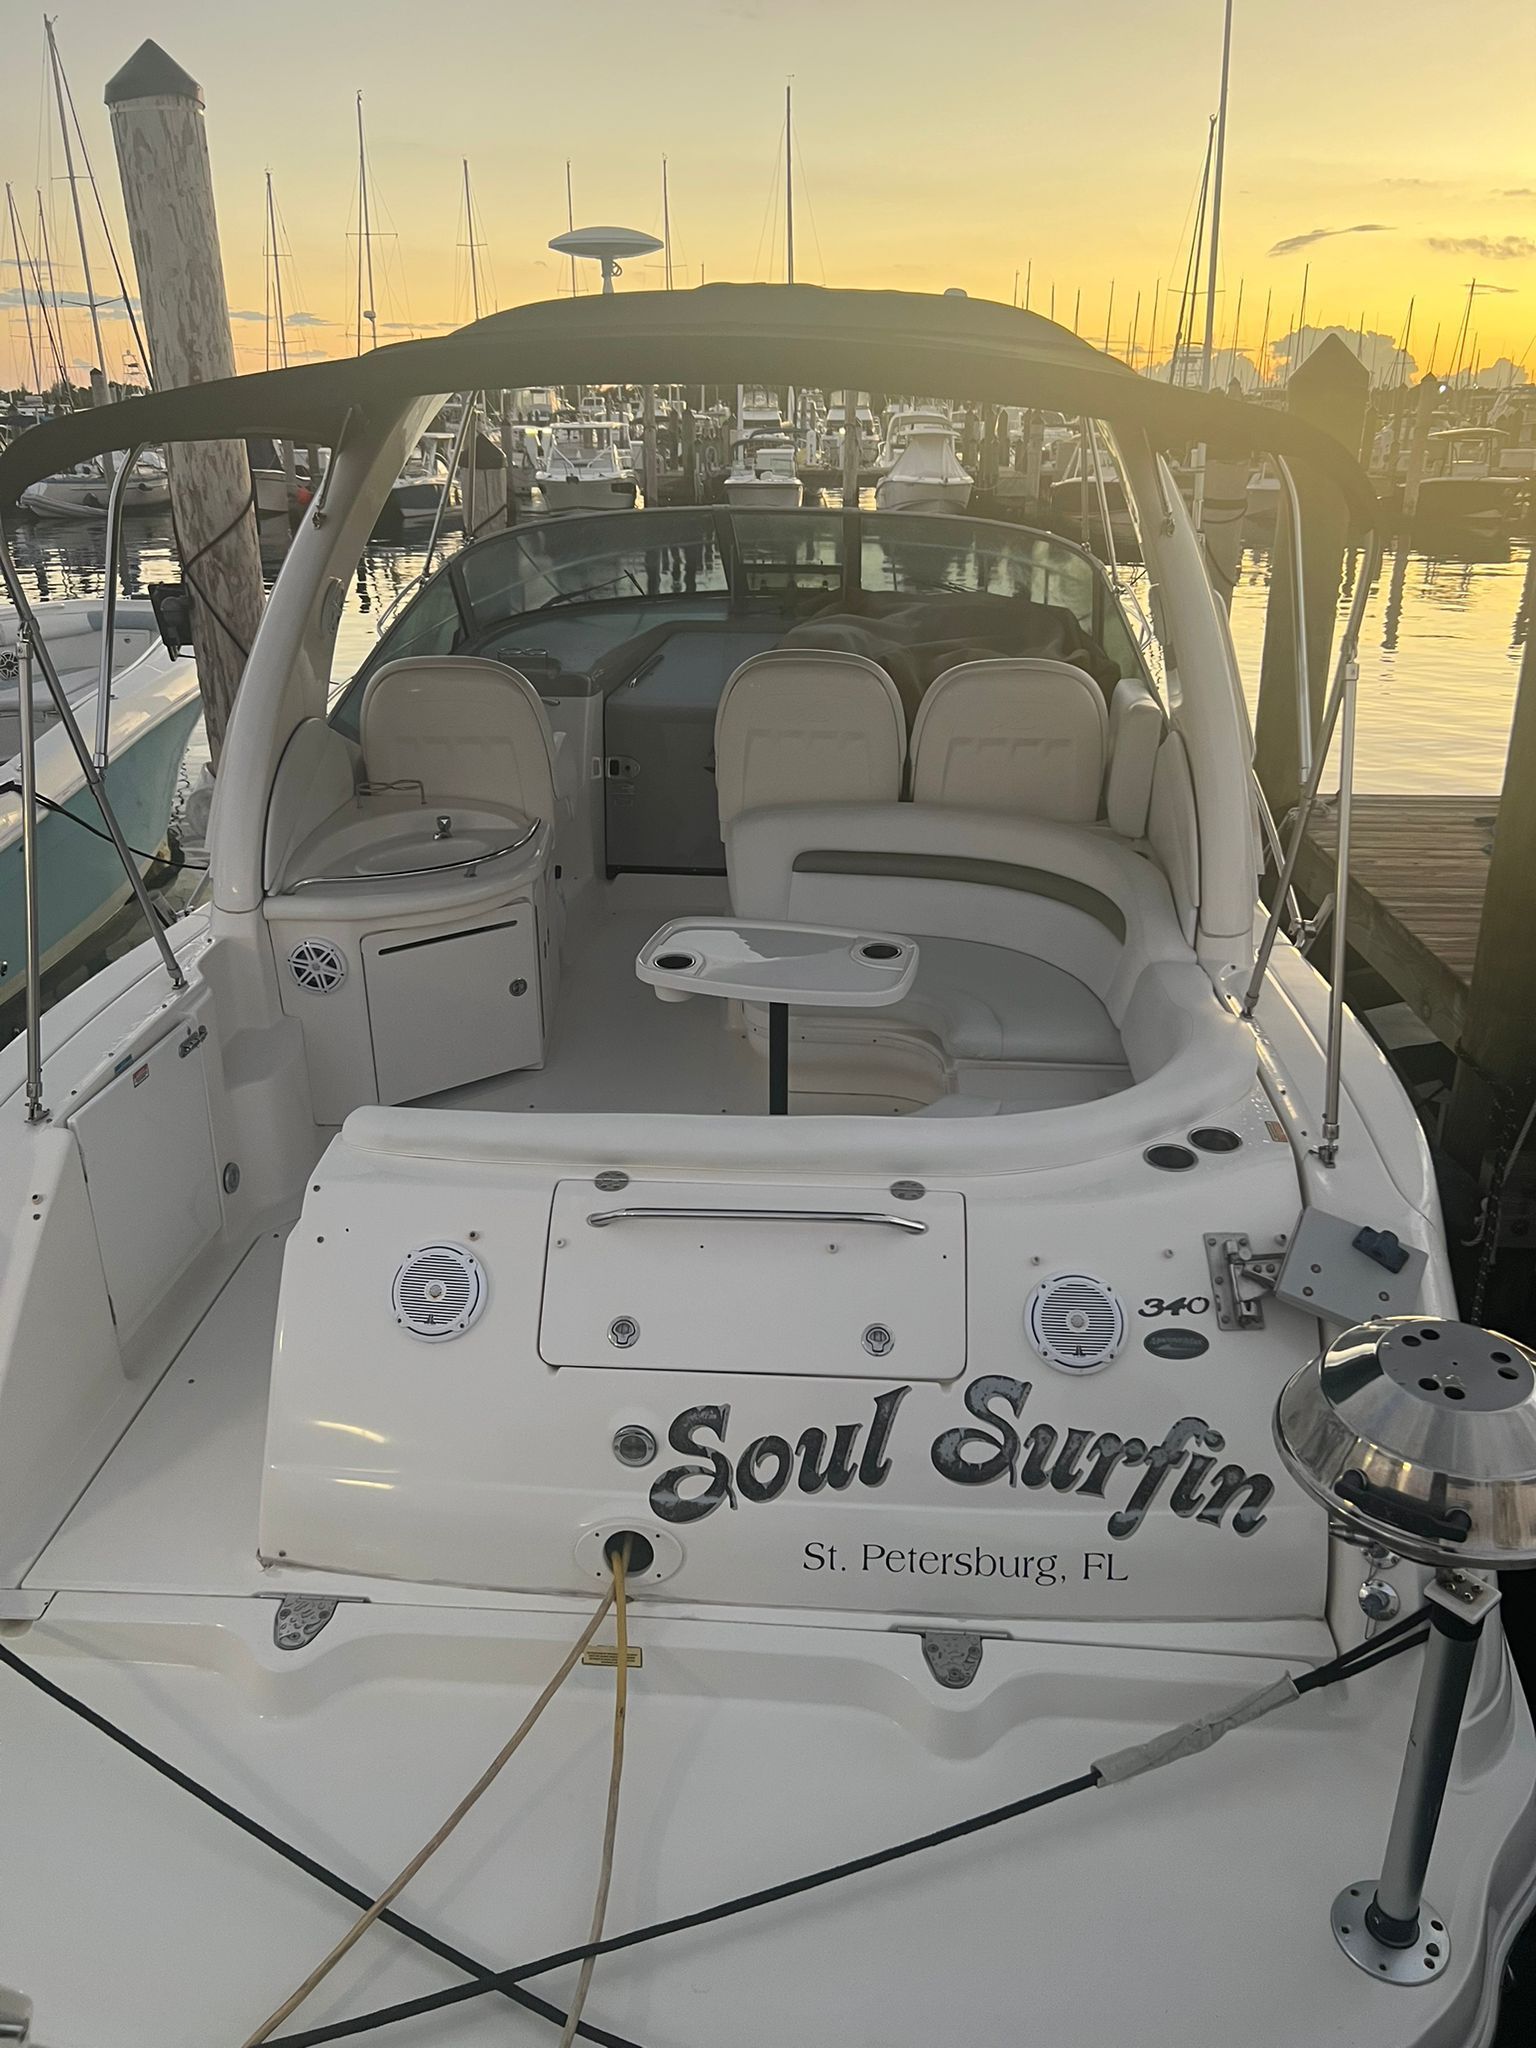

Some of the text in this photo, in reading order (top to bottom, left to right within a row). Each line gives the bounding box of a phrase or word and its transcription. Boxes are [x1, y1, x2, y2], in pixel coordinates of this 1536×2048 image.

[1138, 1297, 1210, 1317] 340
[649, 1374, 1276, 1540] Soul Surfin
[803, 1542, 1129, 1586] St. Petersburg, FL
